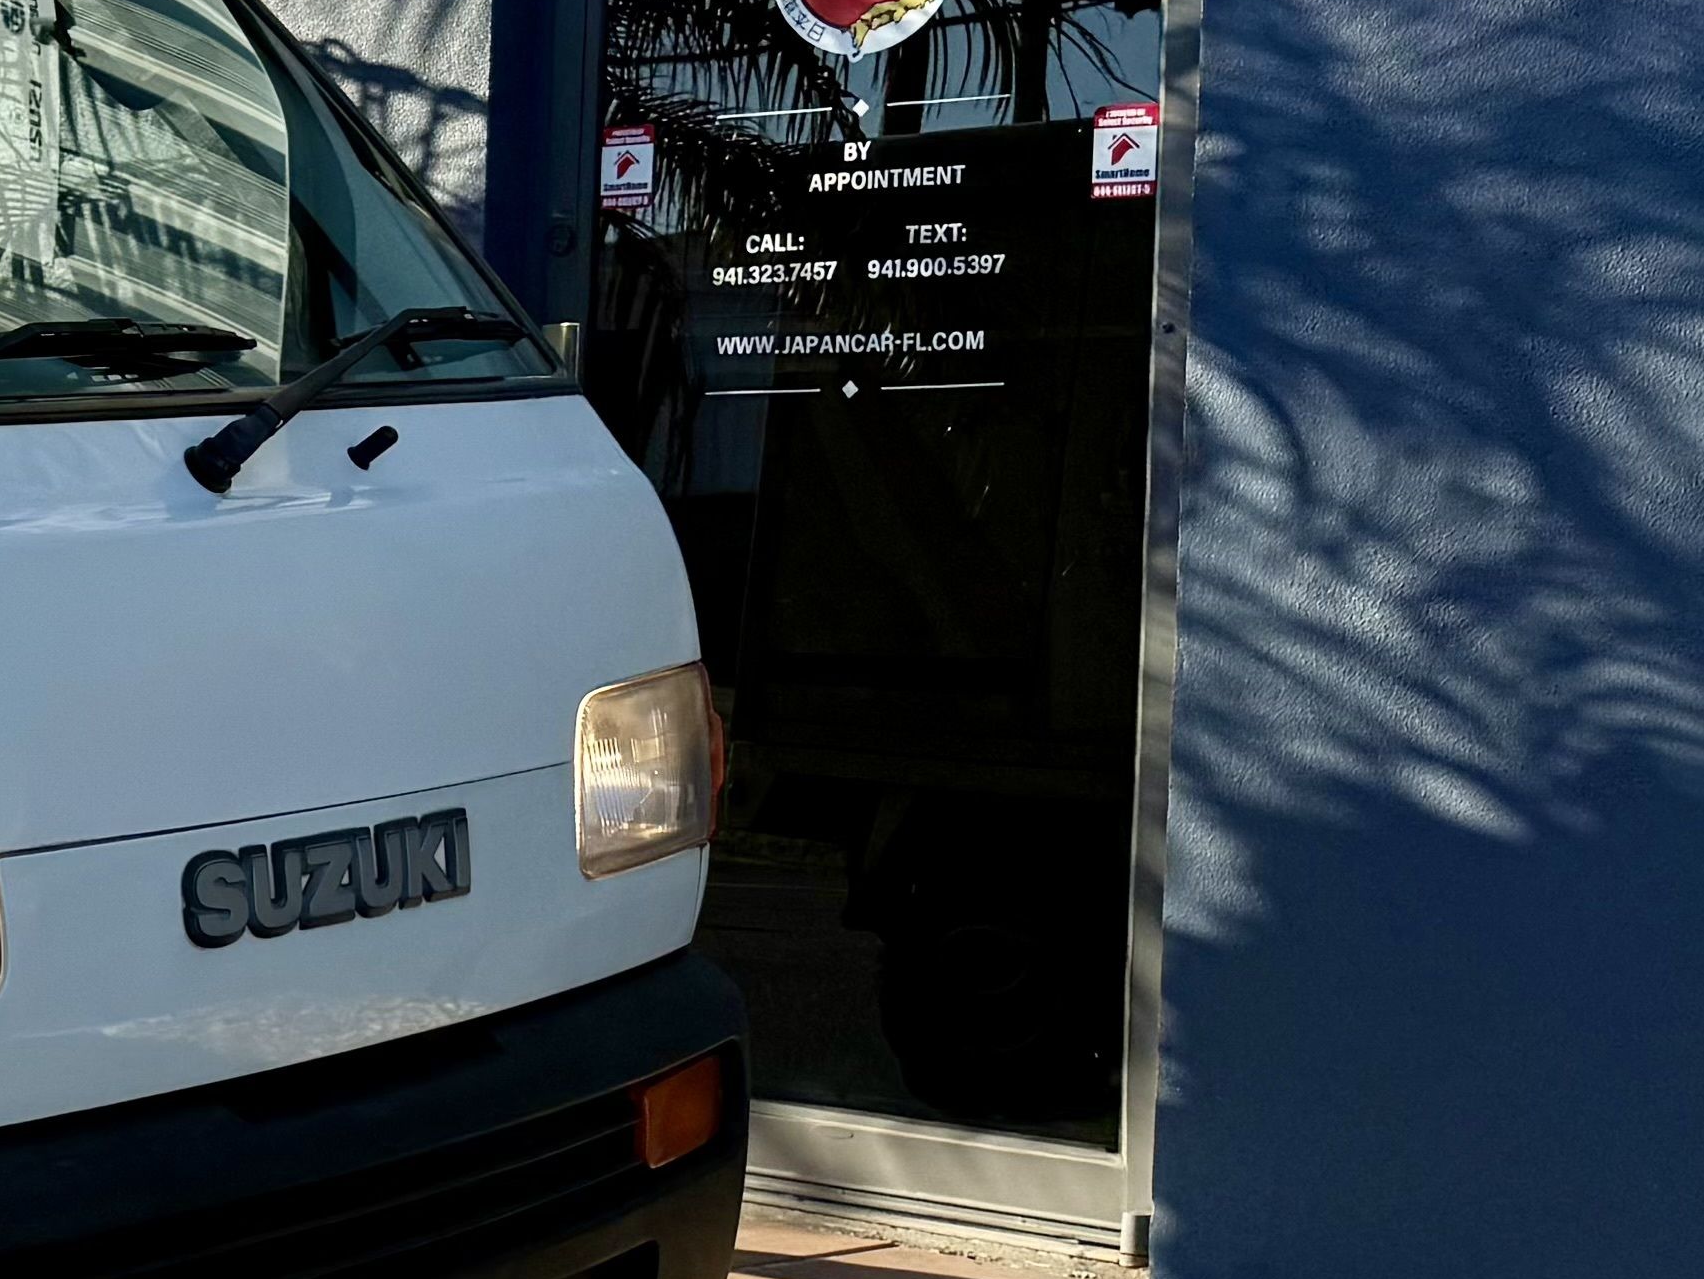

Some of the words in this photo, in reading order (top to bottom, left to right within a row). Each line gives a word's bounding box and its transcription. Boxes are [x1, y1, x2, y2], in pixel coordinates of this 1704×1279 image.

[843, 140, 871, 162] BY
[808, 164, 966, 193] APPOINTMENT
[746, 233, 805, 254] CALL:
[906, 223, 967, 244] TEXT:
[712, 260, 838, 286] 941.323.7457
[867, 254, 1006, 279] 941.900.5397
[717, 330, 985, 356] WWW.JAPANCAR-FL.COM
[181, 806, 472, 949] SUZUKI
